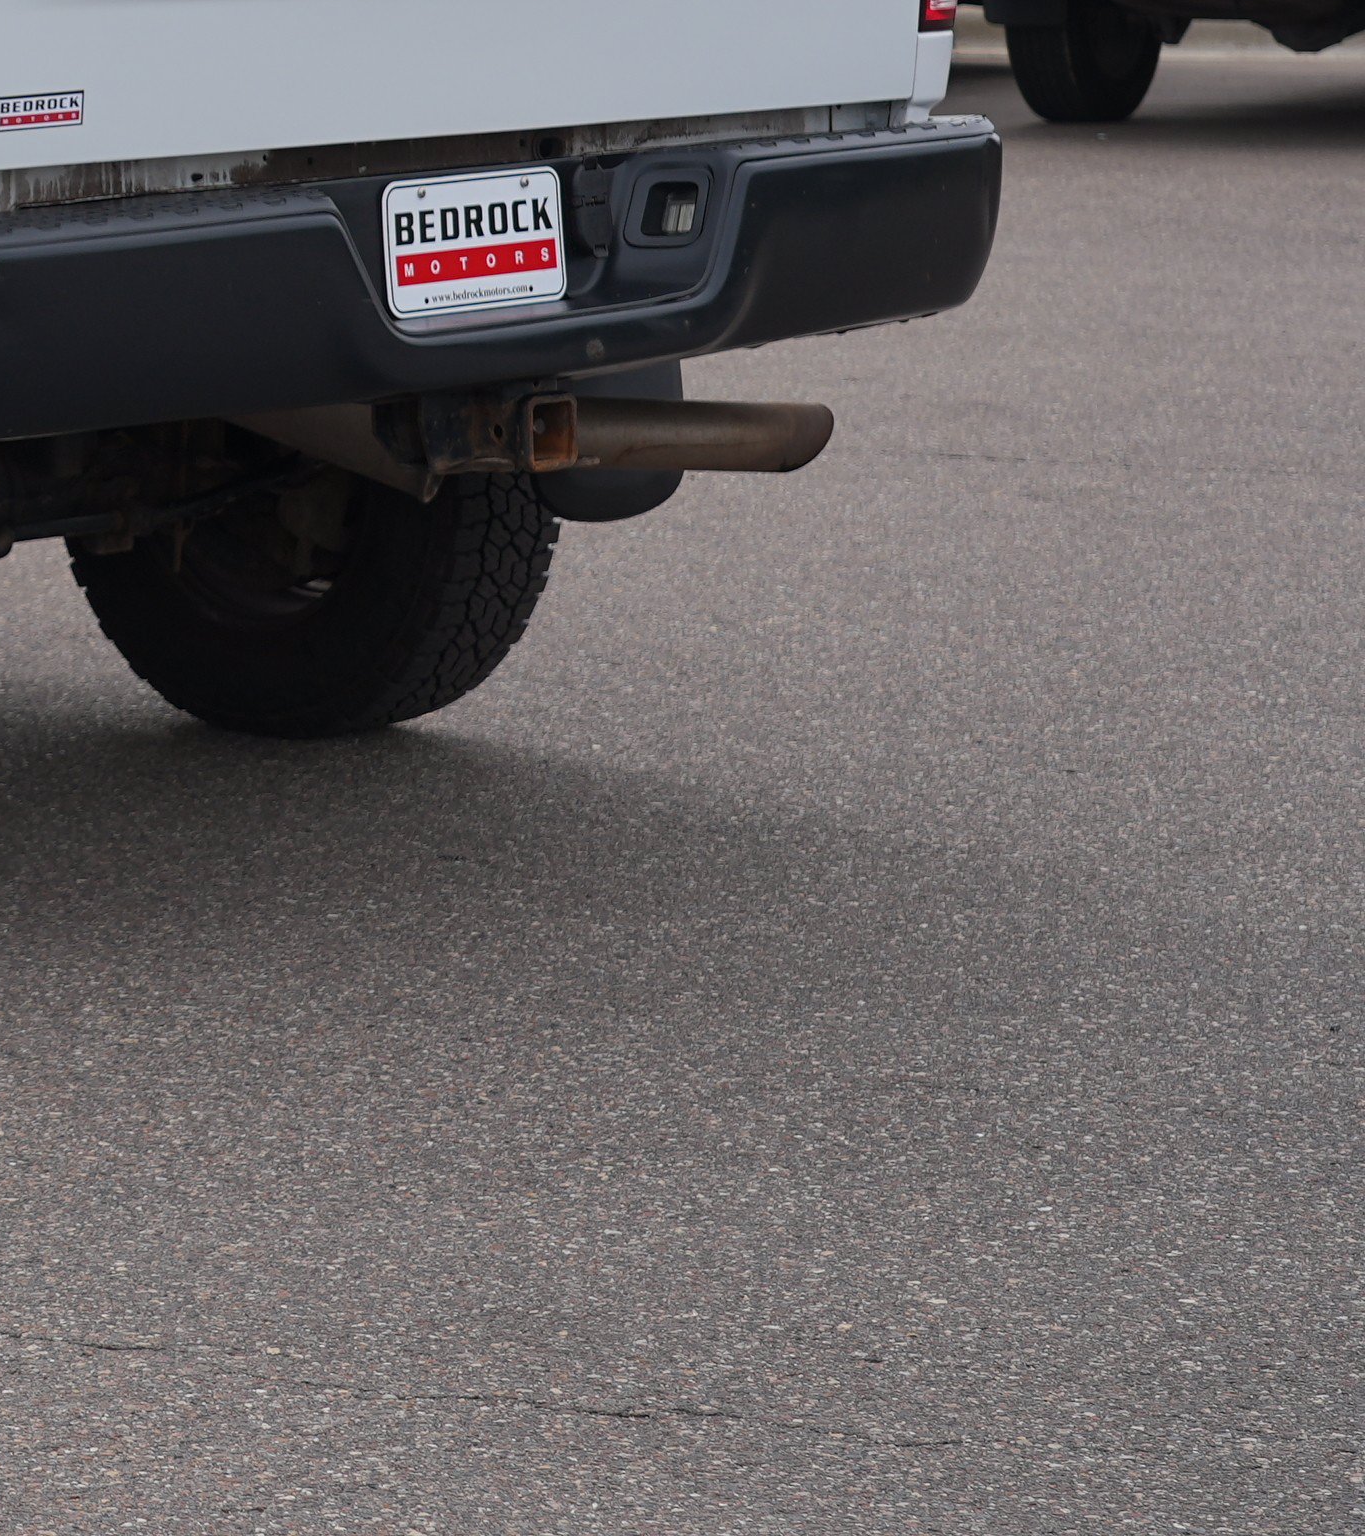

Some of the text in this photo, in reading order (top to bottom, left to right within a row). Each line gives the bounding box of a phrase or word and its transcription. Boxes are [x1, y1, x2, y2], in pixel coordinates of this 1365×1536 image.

[0, 96, 80, 114] BEDROCK
[2, 112, 77, 124] MOTORS
[395, 196, 552, 246] BEDROCK
[404, 247, 550, 278] MOTORS
[431, 283, 528, 304] www.bedrockmotors.com
